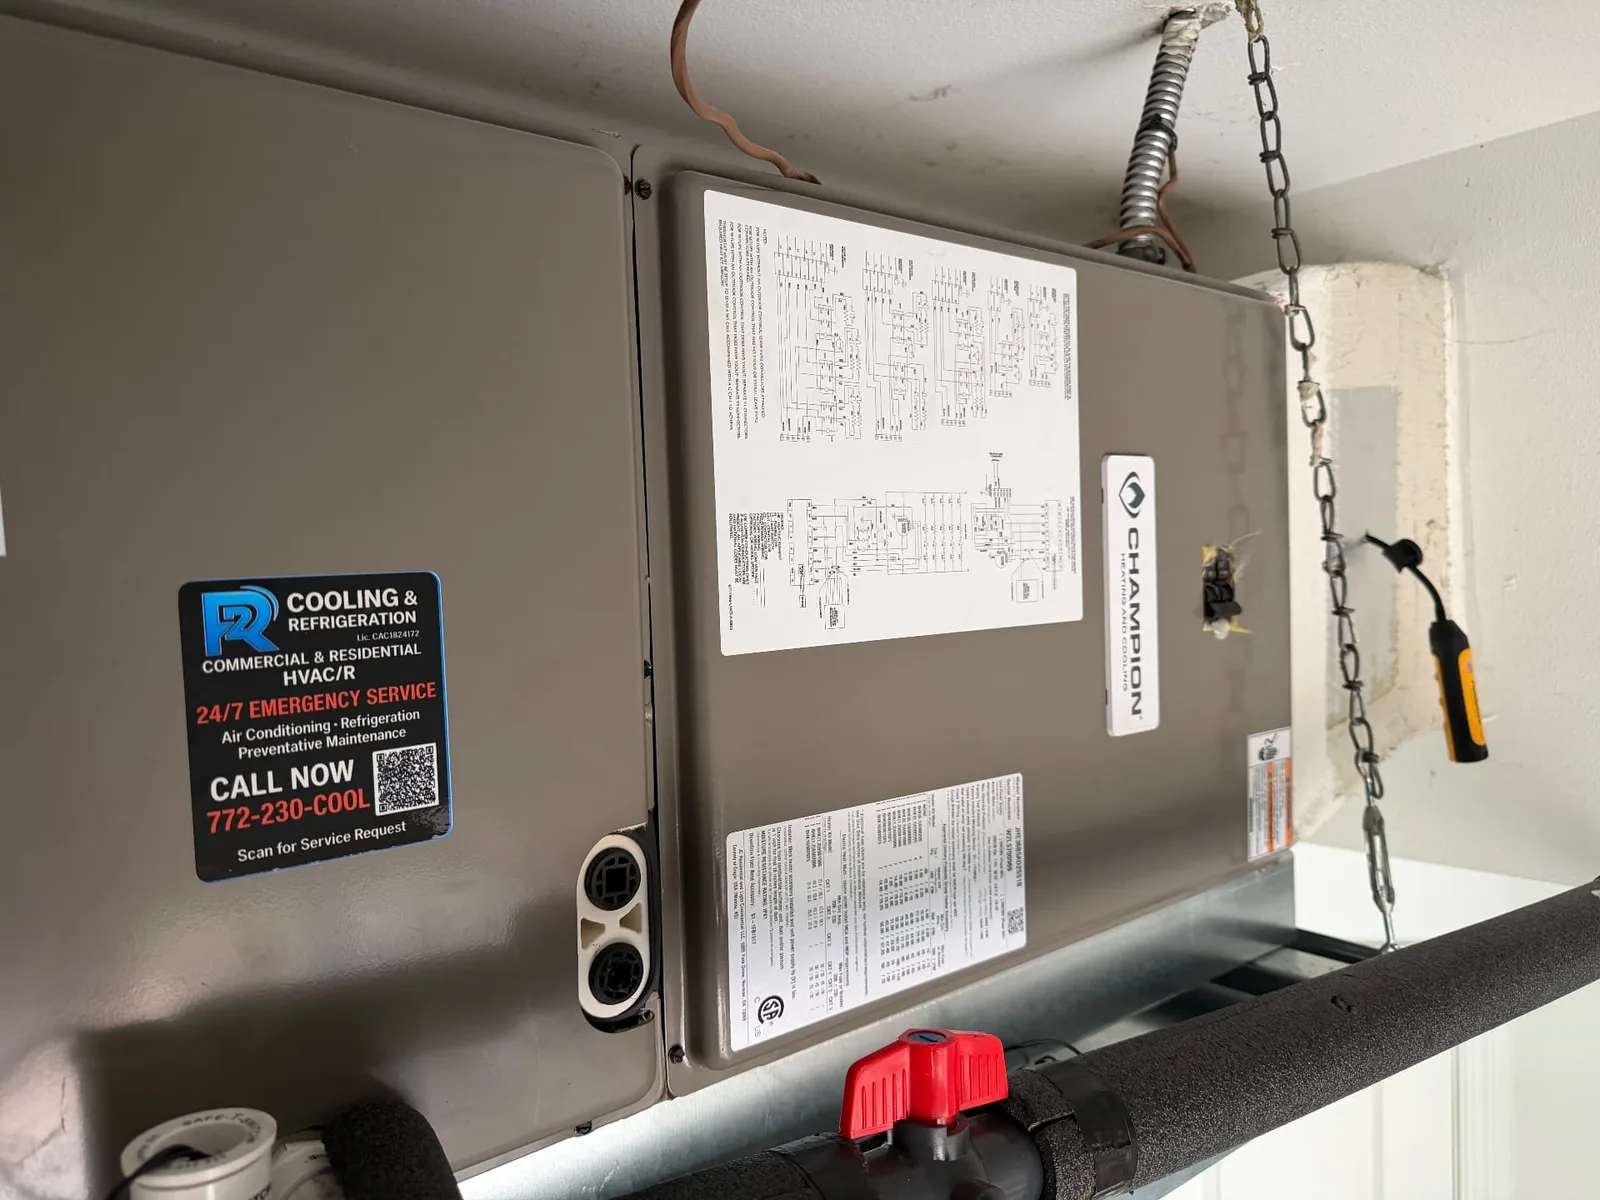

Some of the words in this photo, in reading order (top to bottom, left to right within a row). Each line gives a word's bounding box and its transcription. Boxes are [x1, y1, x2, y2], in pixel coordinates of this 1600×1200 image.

[286, 588, 399, 613] COOLING
[404, 590, 418, 606] &
[288, 611, 417, 632] REFRIGERATION
[356, 634, 371, 642] Lic.
[372, 630, 420, 641] CAC1824172
[1128, 527, 1143, 716] CHAMPION
[202, 652, 310, 674] COMMERCIAL
[314, 651, 325, 664] &
[329, 643, 422, 662] RESIDENTIAL
[283, 665, 356, 687] HVAC/R
[196, 702, 243, 725] 24/7
[249, 690, 361, 719] EMERGENCY
[366, 682, 437, 705] SERVICE
[221, 730, 242, 745] Air
[246, 720, 331, 743] Conditioning
[341, 709, 420, 730] Refrigeration
[238, 739, 322, 760] Preventative
[326, 727, 407, 748] Maintenance
[210, 772, 283, 802] CALL
[291, 759, 355, 790] NOW
[207, 788, 371, 834] 772-230-COOL
[237, 847, 273, 862] Scan
[277, 840, 297, 855] for
[300, 833, 351, 852] Service
[355, 820, 407, 842] Request
